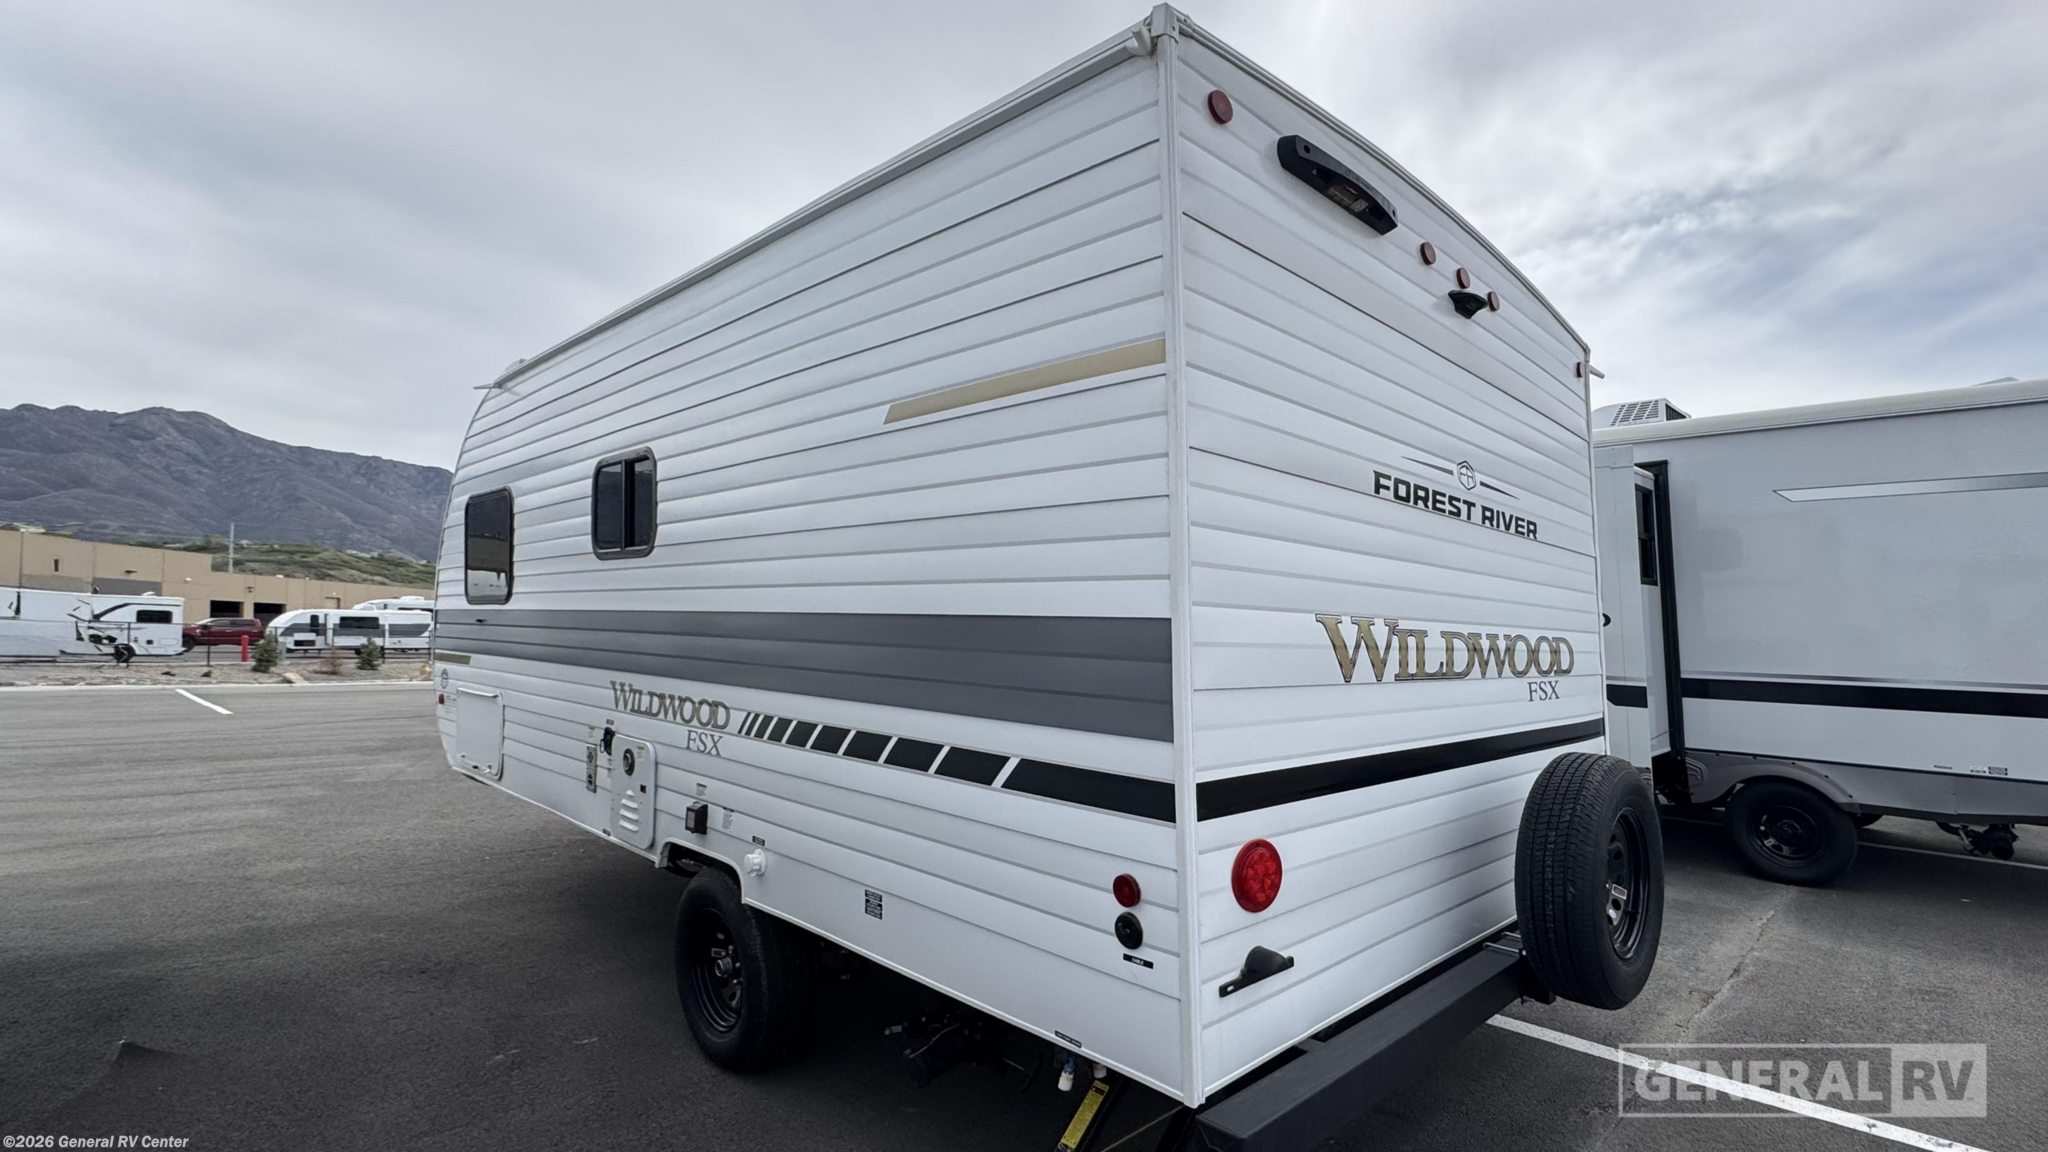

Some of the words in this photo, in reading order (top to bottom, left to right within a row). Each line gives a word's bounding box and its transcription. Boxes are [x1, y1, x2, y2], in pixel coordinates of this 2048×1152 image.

[1373, 470, 1476, 519] FOREST
[1481, 505, 1537, 539] RIVER
[1315, 613, 1574, 682] WILDWOOD
[610, 680, 730, 729] WILDWOOD
[1527, 680, 1560, 701] FSX
[686, 730, 723, 756] FSX
